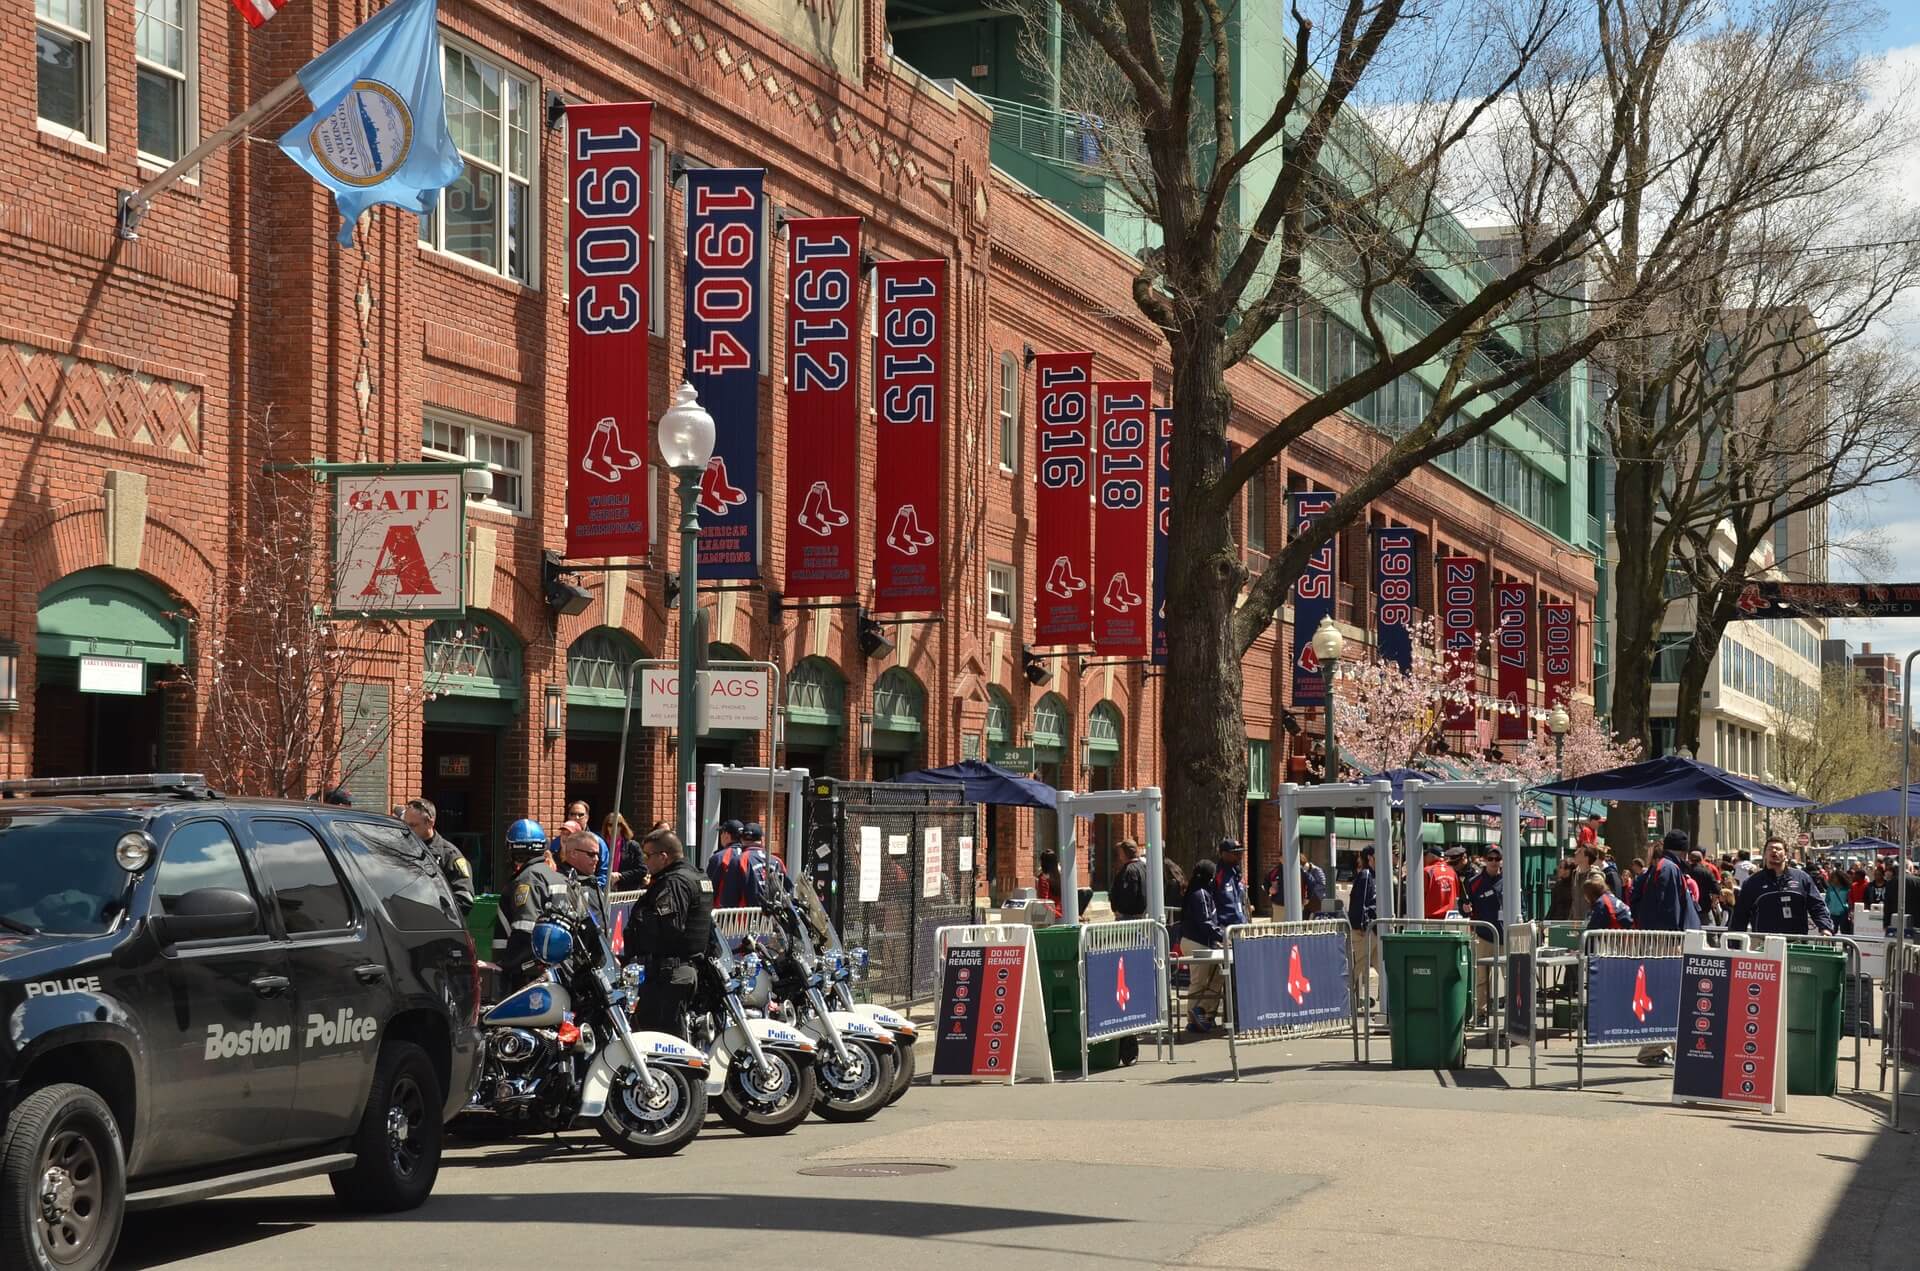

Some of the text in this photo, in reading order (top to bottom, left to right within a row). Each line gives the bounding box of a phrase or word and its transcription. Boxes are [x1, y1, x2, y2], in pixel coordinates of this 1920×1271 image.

[576, 126, 641, 335] 1903
[692, 186, 755, 375] 1904
[795, 236, 850, 392] 1912
[884, 277, 936, 424] 1915
[1042, 366, 1087, 489] 1916
[1102, 394, 1145, 510] 1918
[349, 489, 449, 512] GATE
[361, 525, 442, 595] A
[1298, 501, 1332, 598] 175
[1380, 536, 1411, 626] 1986
[1446, 565, 1474, 650] 2004
[1868, 603, 1912, 612] GATE D
[1500, 590, 1526, 668] 2007
[1547, 608, 1570, 675] 2013
[711, 680, 760, 697] AGS
[1004, 752, 1020, 760] 20
[948, 958, 982, 966] REMOVE
[991, 949, 1020, 958] DO NOT
[1689, 958, 1726, 968] PLEASE
[1686, 966, 1728, 978] REMOVE
[1736, 970, 1777, 982] REMOVE
[1738, 961, 1775, 972] DO NOT
[25, 976, 102, 1000] POLICE
[848, 1022, 874, 1034] Police
[872, 1012, 898, 1024] Police
[204, 1007, 378, 1061] Boston Police
[768, 1029, 797, 1042] Police
[654, 1042, 686, 1055] Police
